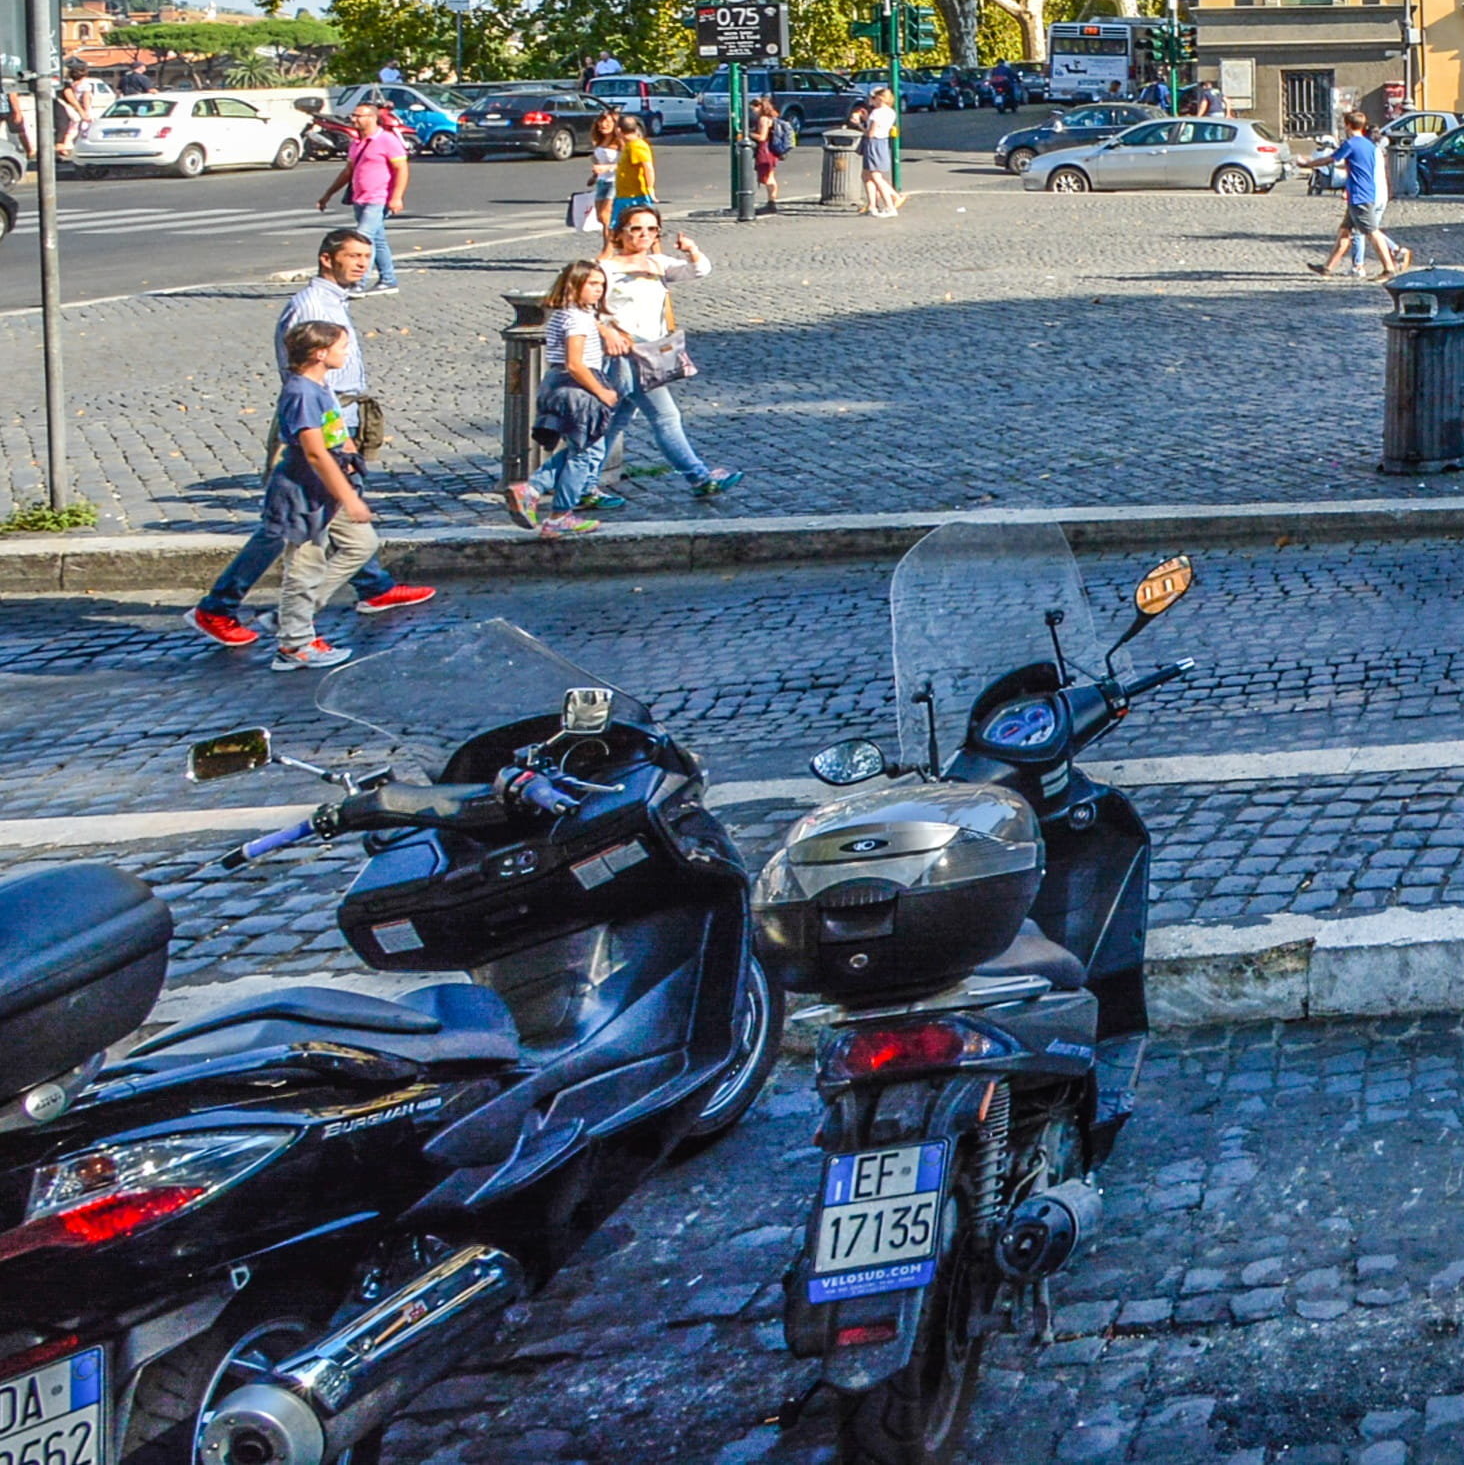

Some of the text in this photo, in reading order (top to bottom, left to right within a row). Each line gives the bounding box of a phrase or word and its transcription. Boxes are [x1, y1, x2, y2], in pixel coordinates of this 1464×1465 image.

[716, 7, 760, 27] 0,75
[855, 1152, 899, 1198] EF
[830, 1202, 932, 1259] 17135
[821, 1263, 922, 1288] VELOSUD.COM
[0, 1421, 92, 1465] 562
